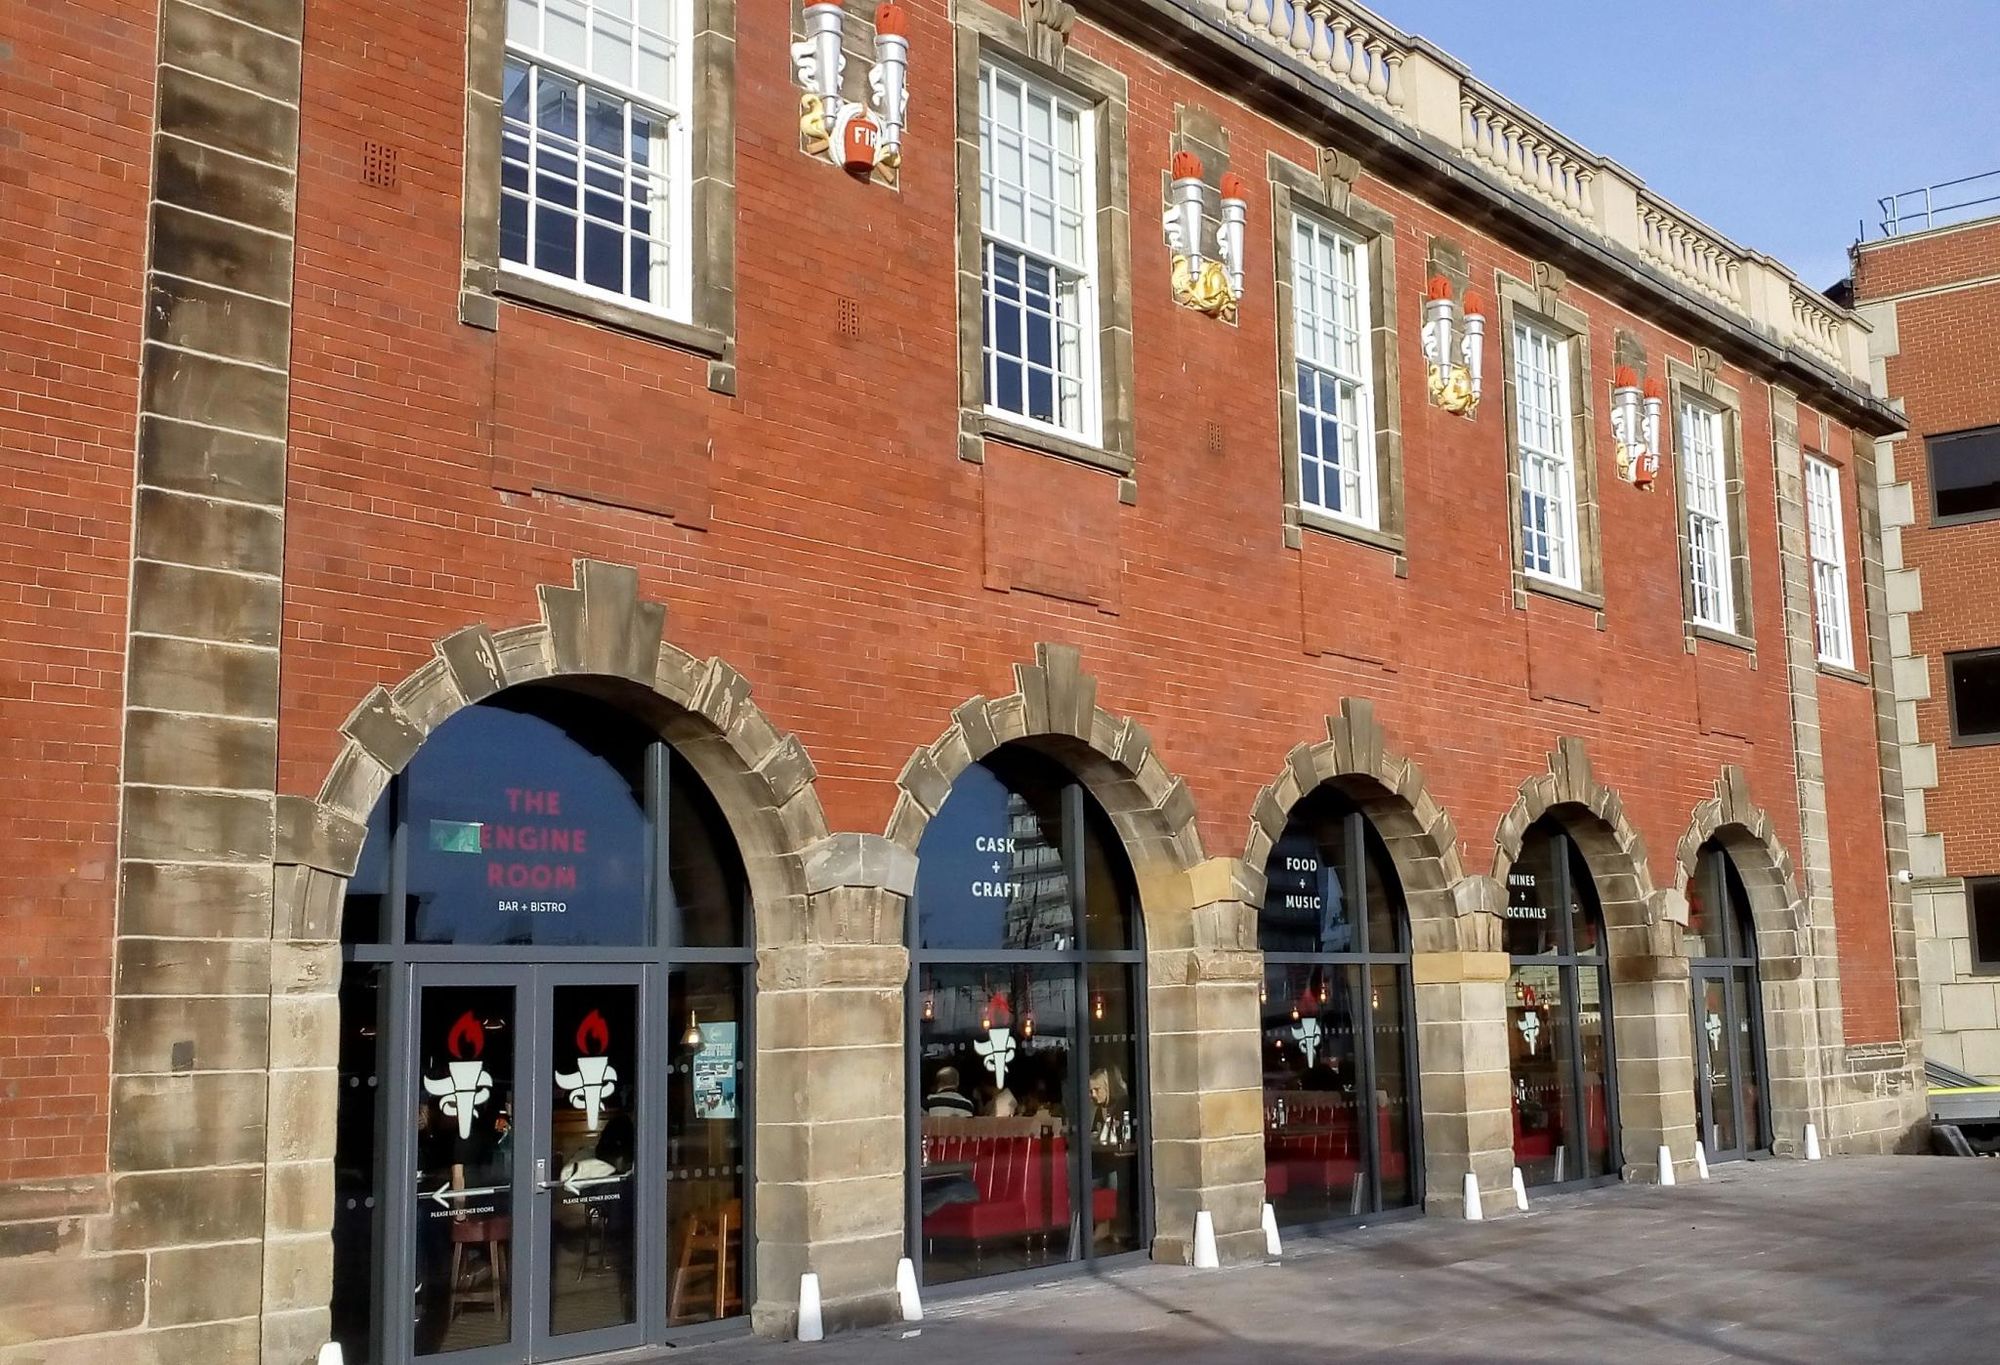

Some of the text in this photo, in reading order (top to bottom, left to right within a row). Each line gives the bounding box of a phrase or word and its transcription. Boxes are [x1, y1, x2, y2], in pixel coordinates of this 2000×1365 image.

[505, 787, 561, 816] THE
[480, 824, 587, 853] ENGINE
[975, 836, 1016, 853] CASK
[1286, 857, 1317, 872] FOOD
[487, 861, 577, 890] ROOM
[1508, 874, 1536, 886] WINES
[971, 881, 1021, 898] CRAFT
[498, 900, 519, 912] BAR
[530, 901, 567, 913] BISTRO
[1285, 895, 1321, 910] MUSIC
[430, 1210, 448, 1218] PLEASE
